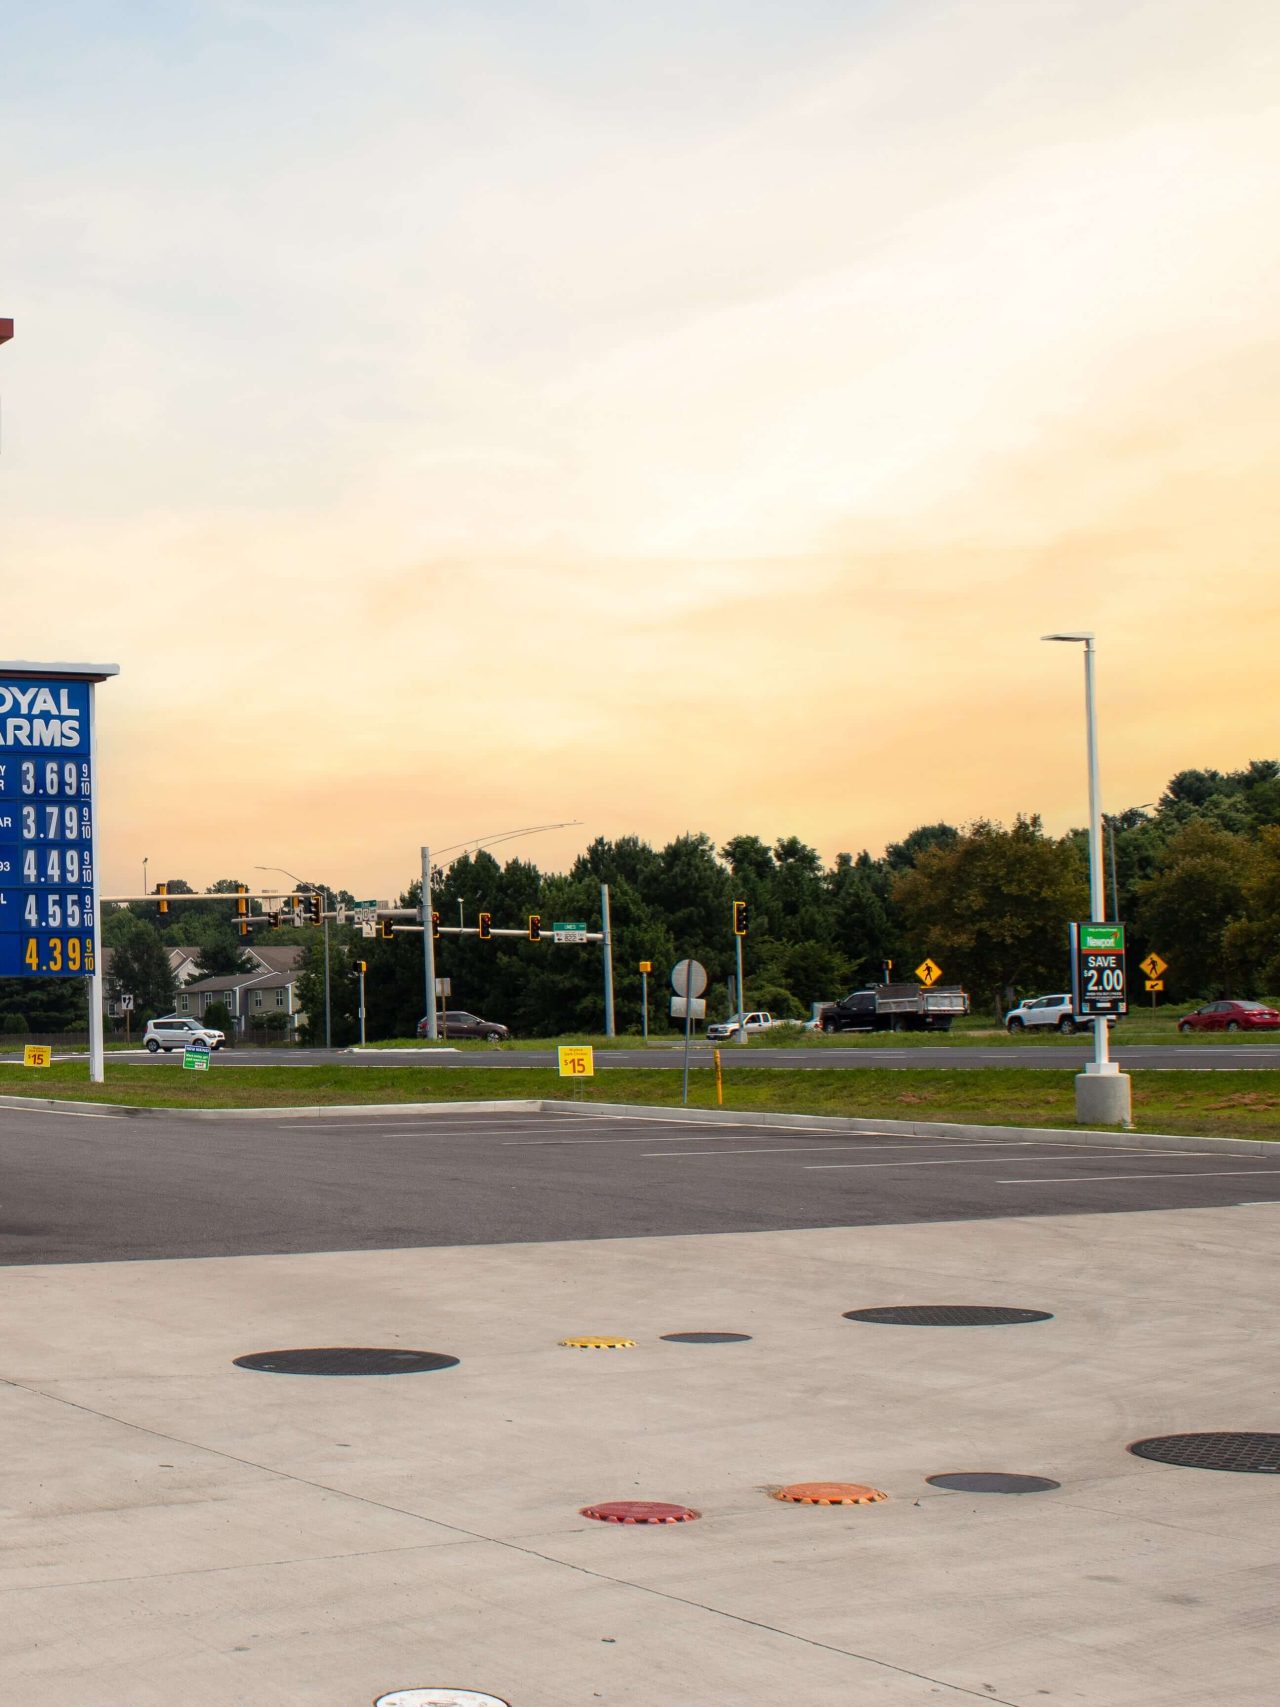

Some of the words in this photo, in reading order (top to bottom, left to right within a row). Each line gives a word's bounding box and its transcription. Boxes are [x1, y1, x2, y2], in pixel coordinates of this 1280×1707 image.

[22, 762, 77, 795] 3.69
[22, 806, 78, 839] 3.79
[23, 850, 78, 882] 4.49
[24, 894, 80, 927] 4.55
[26, 938, 80, 971] 4.39
[1088, 956, 1117, 968] SAVE
[1084, 969, 1124, 990] $2.00
[28, 1054, 44, 1065] $15
[564, 1058, 586, 1074] $15
